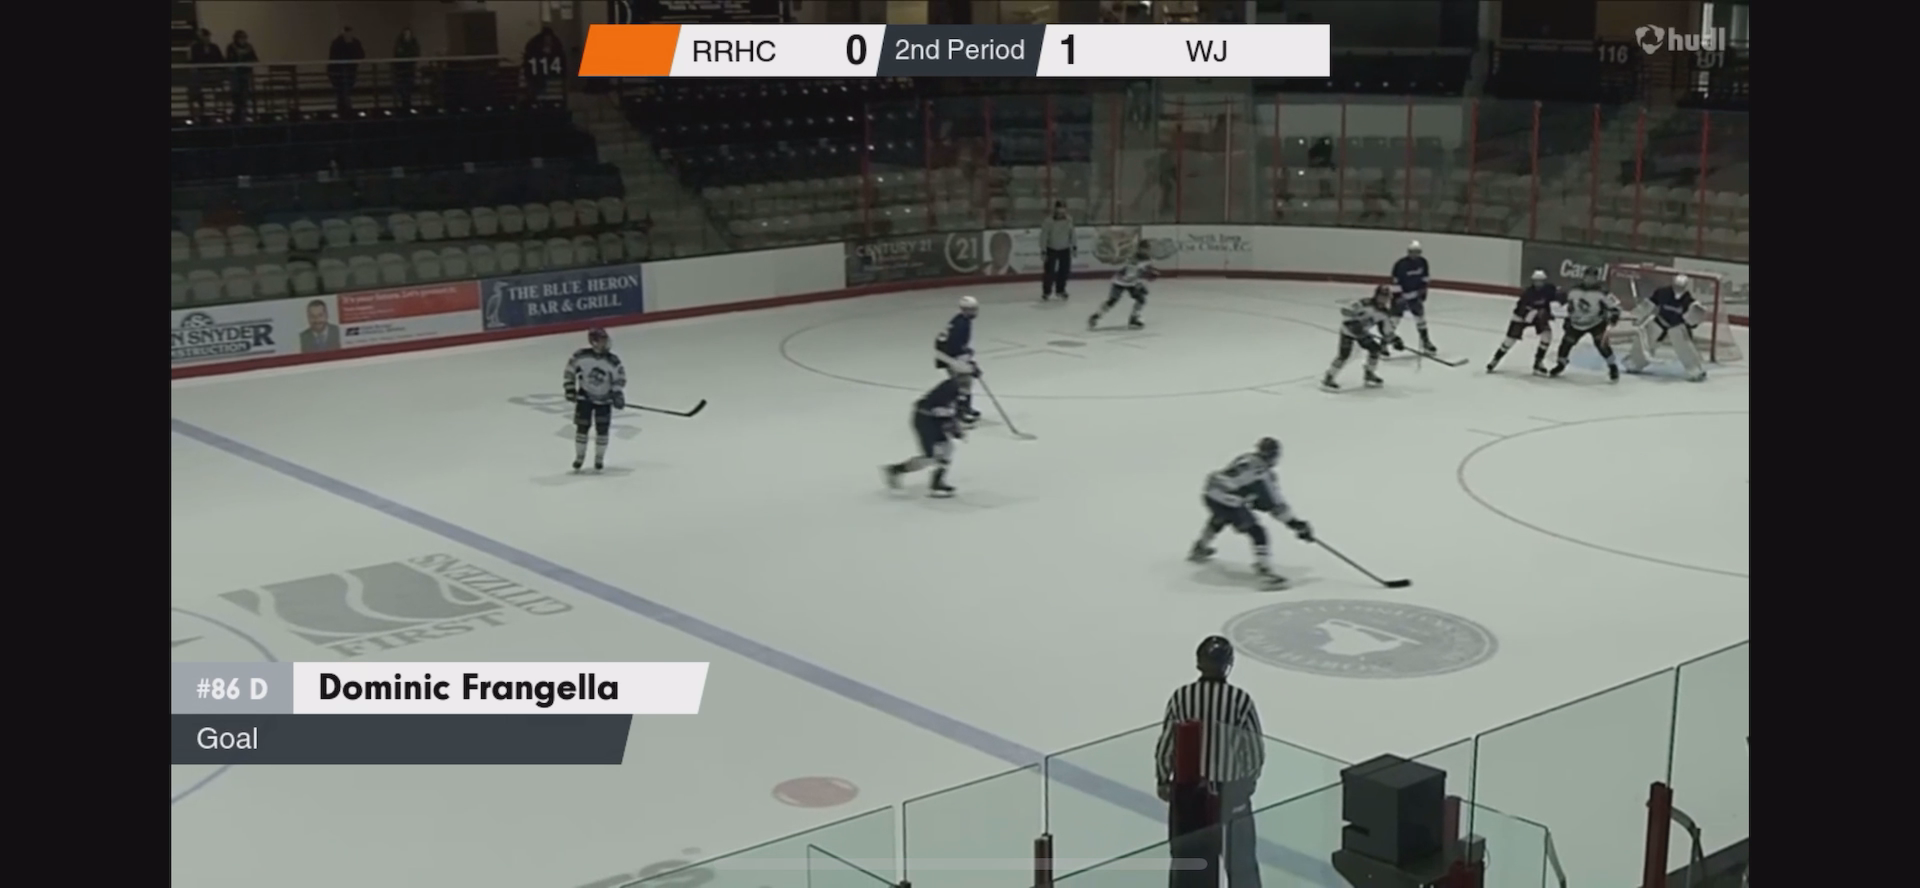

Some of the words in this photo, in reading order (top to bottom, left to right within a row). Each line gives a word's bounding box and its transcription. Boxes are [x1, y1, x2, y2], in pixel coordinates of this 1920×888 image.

[528, 56, 563, 75] 114
[1599, 44, 1628, 64] 116
[856, 240, 916, 257] CENTURY
[920, 239, 933, 252] 21
[956, 237, 978, 260] 21
[508, 284, 540, 301] THE
[543, 280, 583, 298] BLUE
[587, 274, 639, 292] HERON
[528, 301, 558, 316] BAR
[561, 299, 573, 313] &
[576, 293, 622, 312] GRILL
[187, 323, 276, 346] SNYDER
[407, 553, 574, 616] CITIZENS
[326, 612, 507, 658] FIRST
